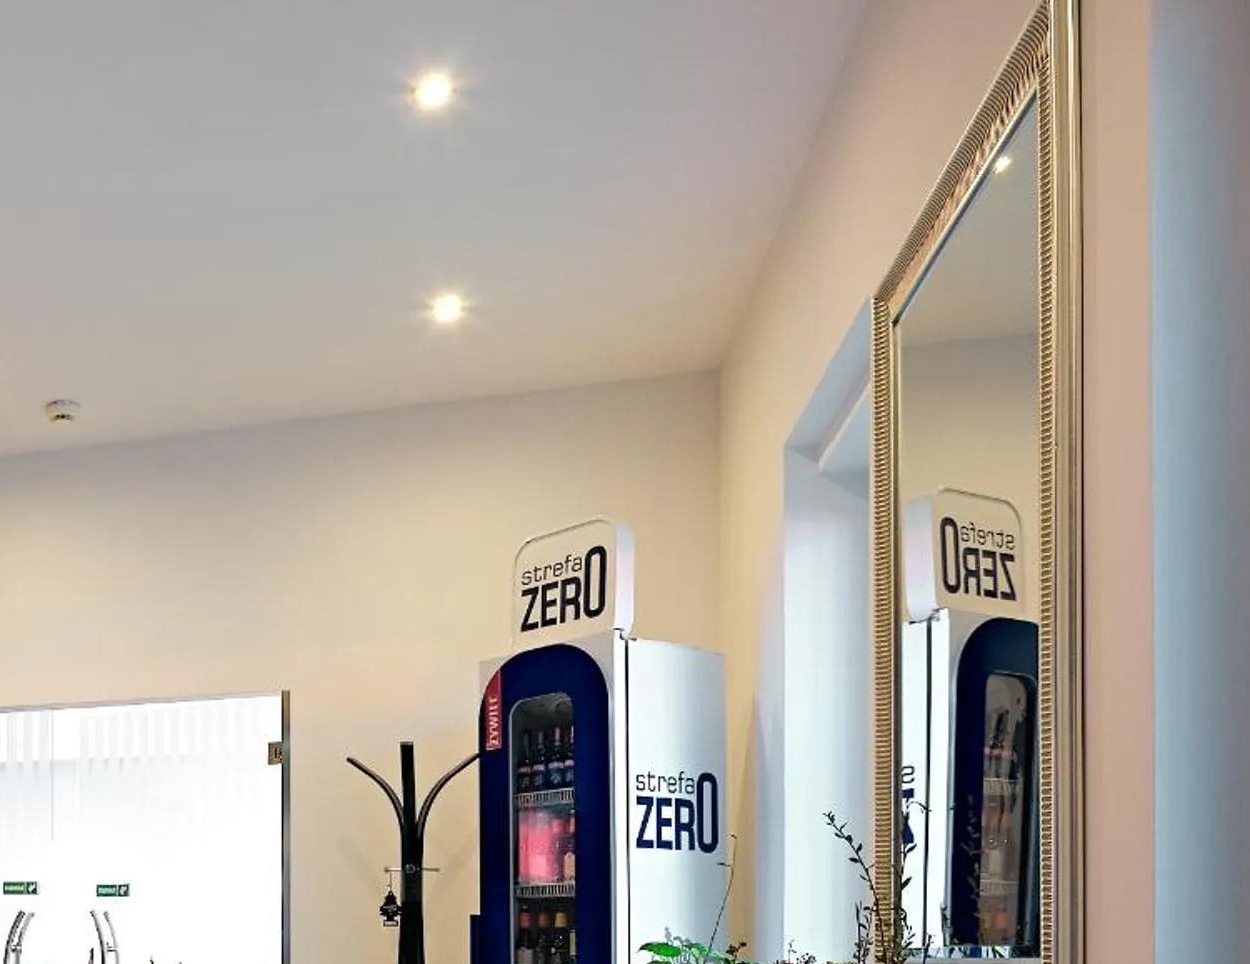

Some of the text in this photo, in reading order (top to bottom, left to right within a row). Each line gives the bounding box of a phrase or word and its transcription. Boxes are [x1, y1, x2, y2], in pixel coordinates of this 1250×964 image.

[521, 554, 583, 586] strefa
[521, 545, 607, 632] ZERO
[636, 771, 695, 794] strefa
[636, 772, 719, 854] ZERO
